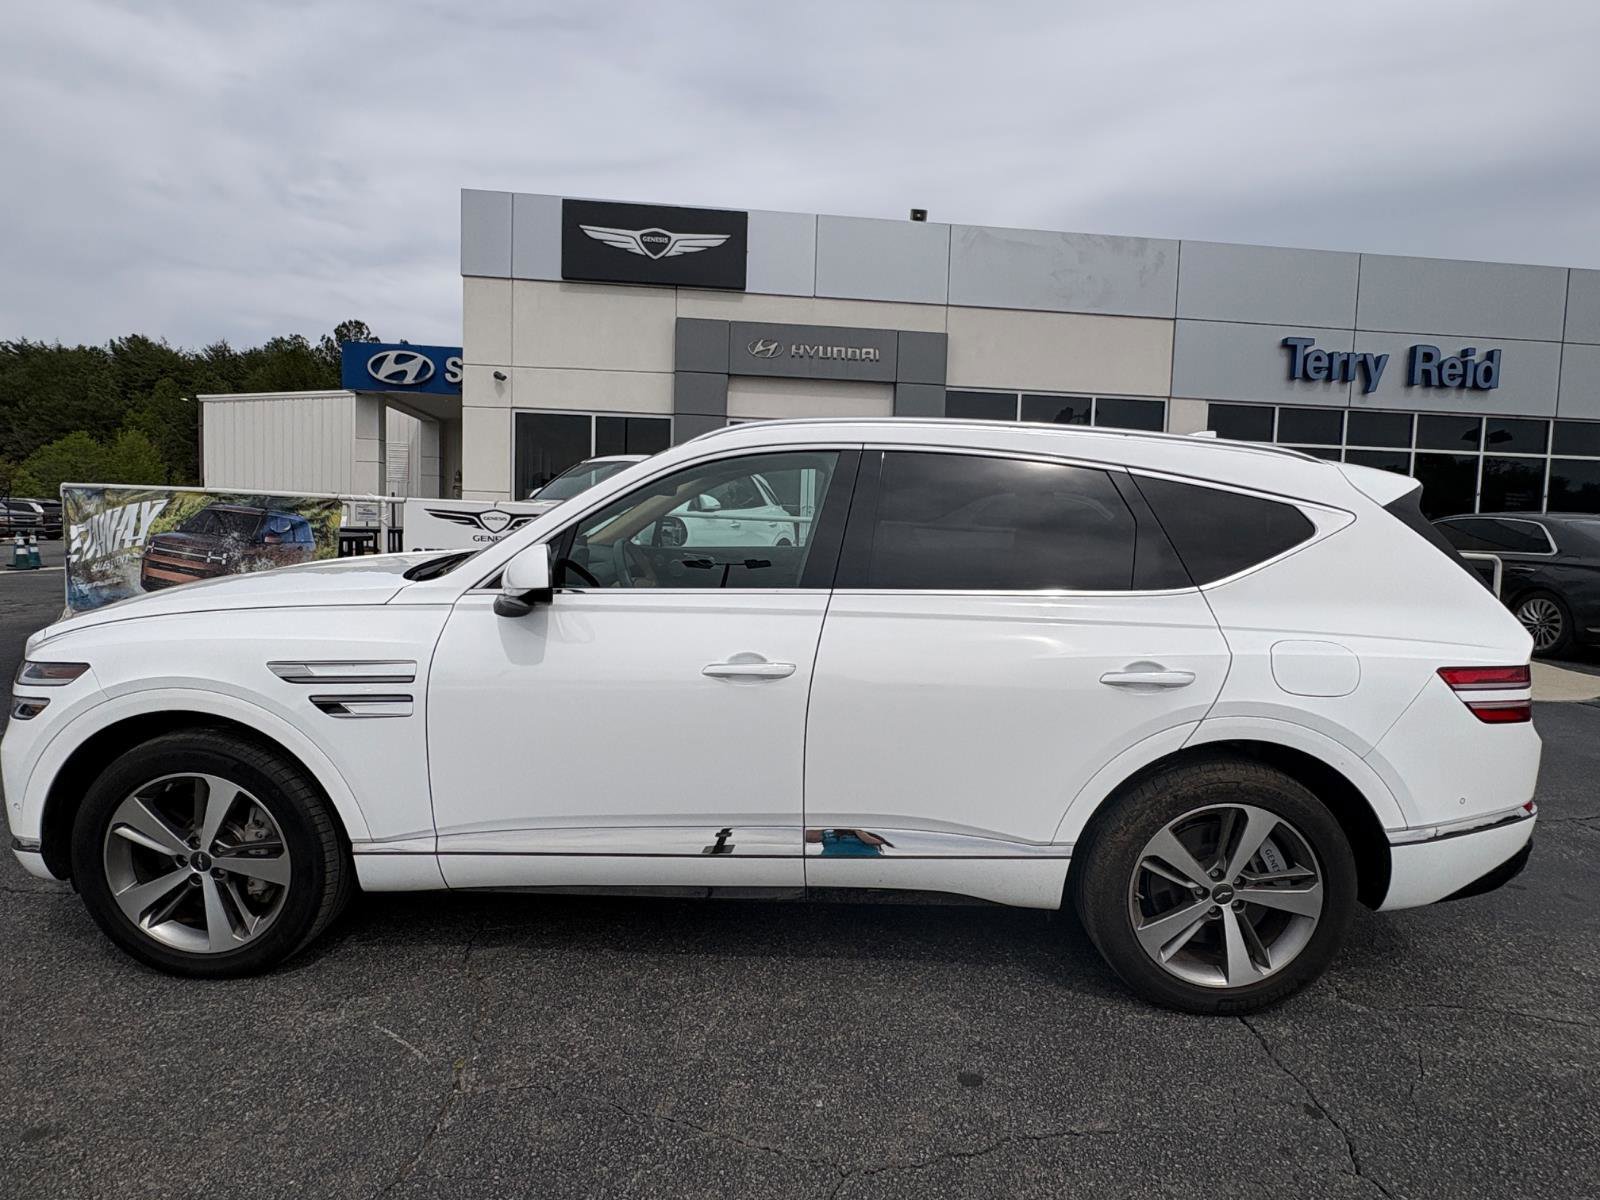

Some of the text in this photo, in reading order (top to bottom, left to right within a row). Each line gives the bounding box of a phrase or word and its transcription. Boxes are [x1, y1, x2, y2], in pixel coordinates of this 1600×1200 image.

[642, 235, 669, 244] GENESIS
[791, 344, 880, 361] HYUNDAI
[1281, 336, 1502, 394] Terry Reid
